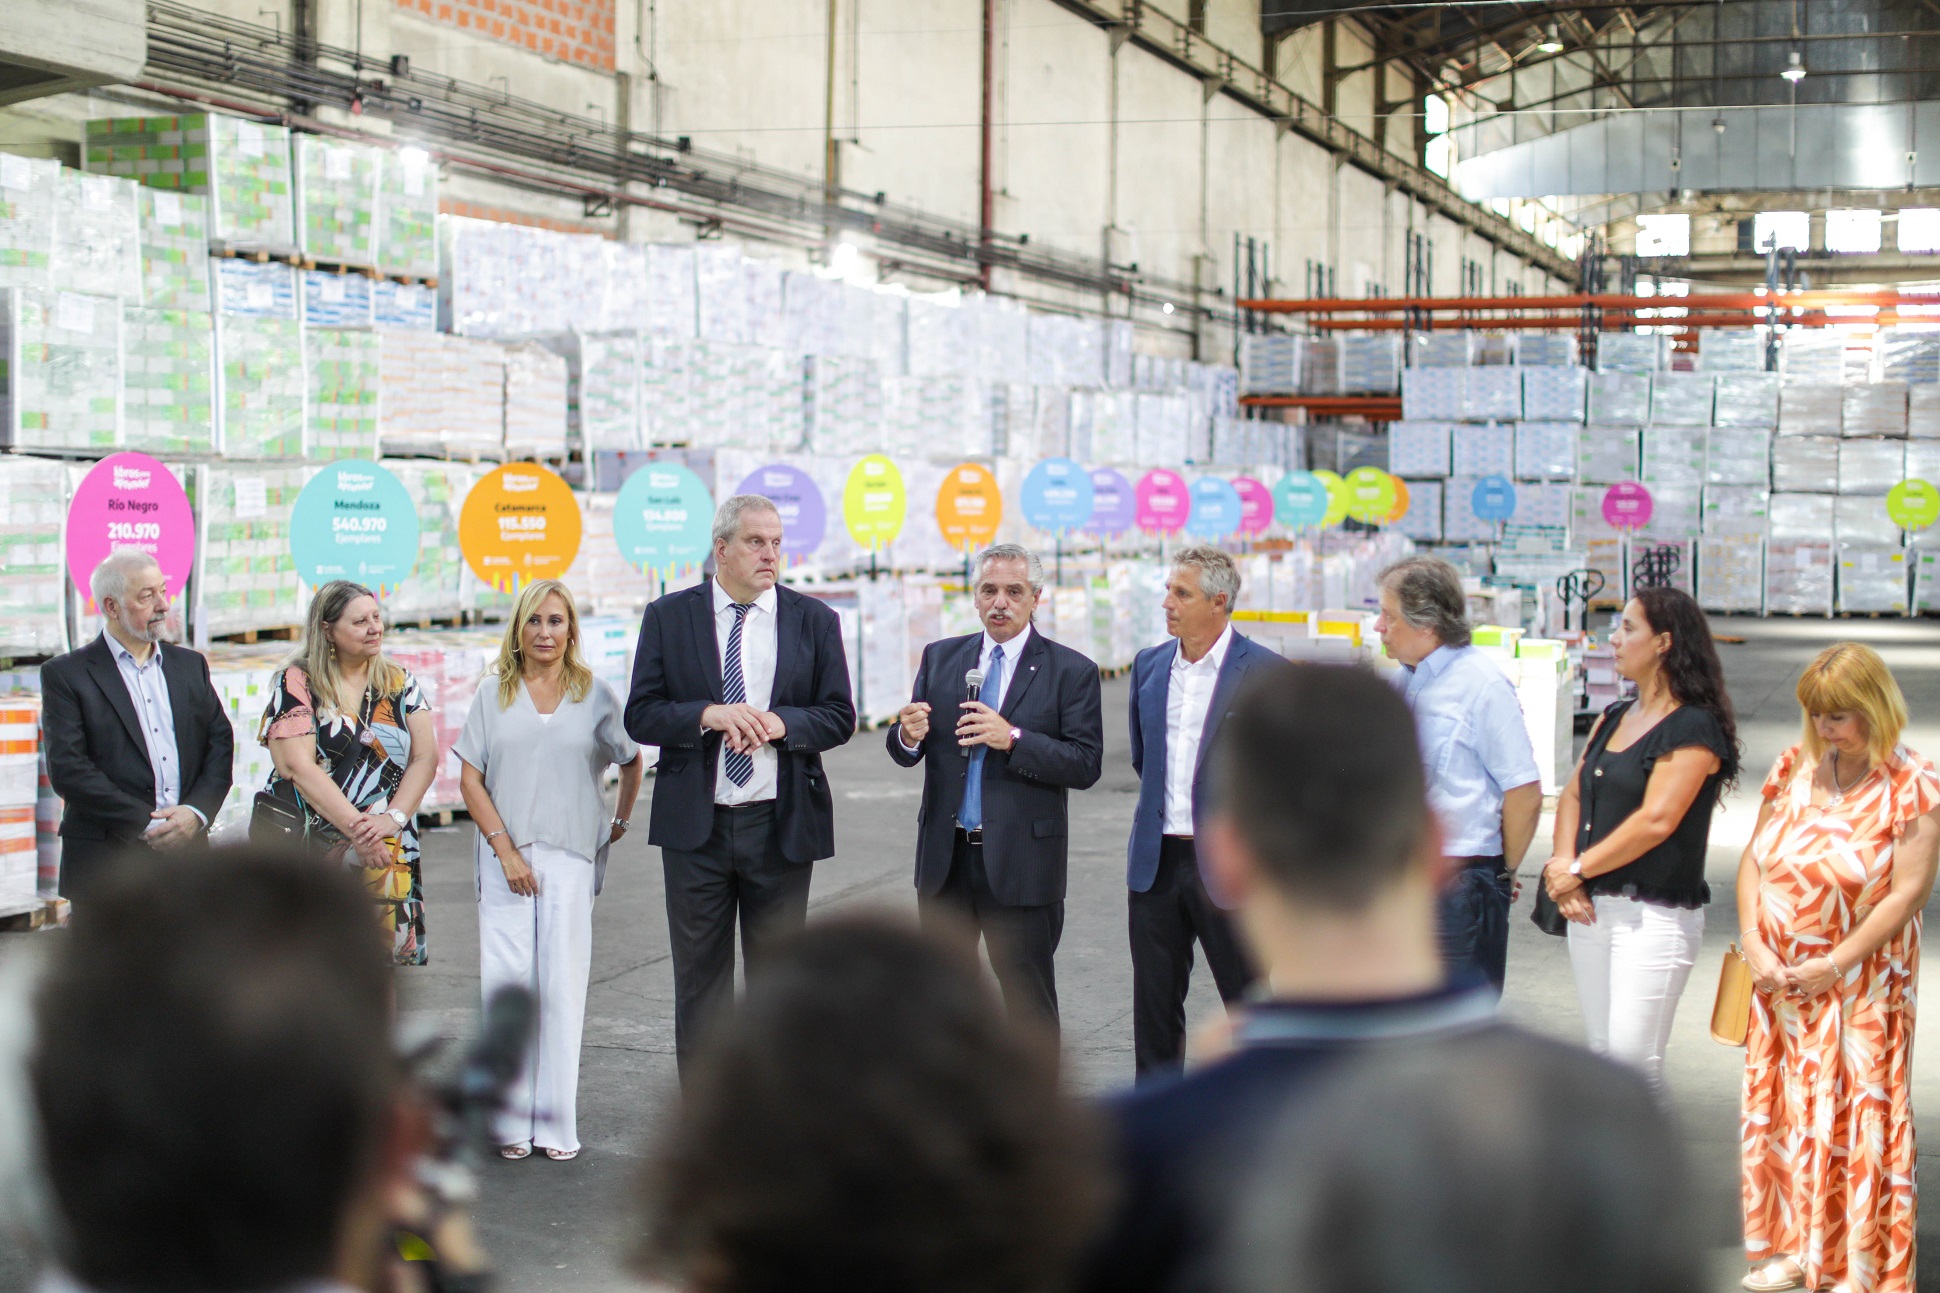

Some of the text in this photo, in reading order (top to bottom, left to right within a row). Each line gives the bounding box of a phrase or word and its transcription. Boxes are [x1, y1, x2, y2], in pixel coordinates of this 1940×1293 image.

[108, 499, 159, 514] Río Negro
[334, 500, 380, 510] Mendoza
[495, 503, 546, 513] Catamarca
[332, 517, 387, 532] 540.970
[498, 516, 546, 530] 115.550
[107, 522, 160, 540] 210.970
[500, 530, 546, 541] Ejemplares
[335, 532, 382, 544] Ejemplares
